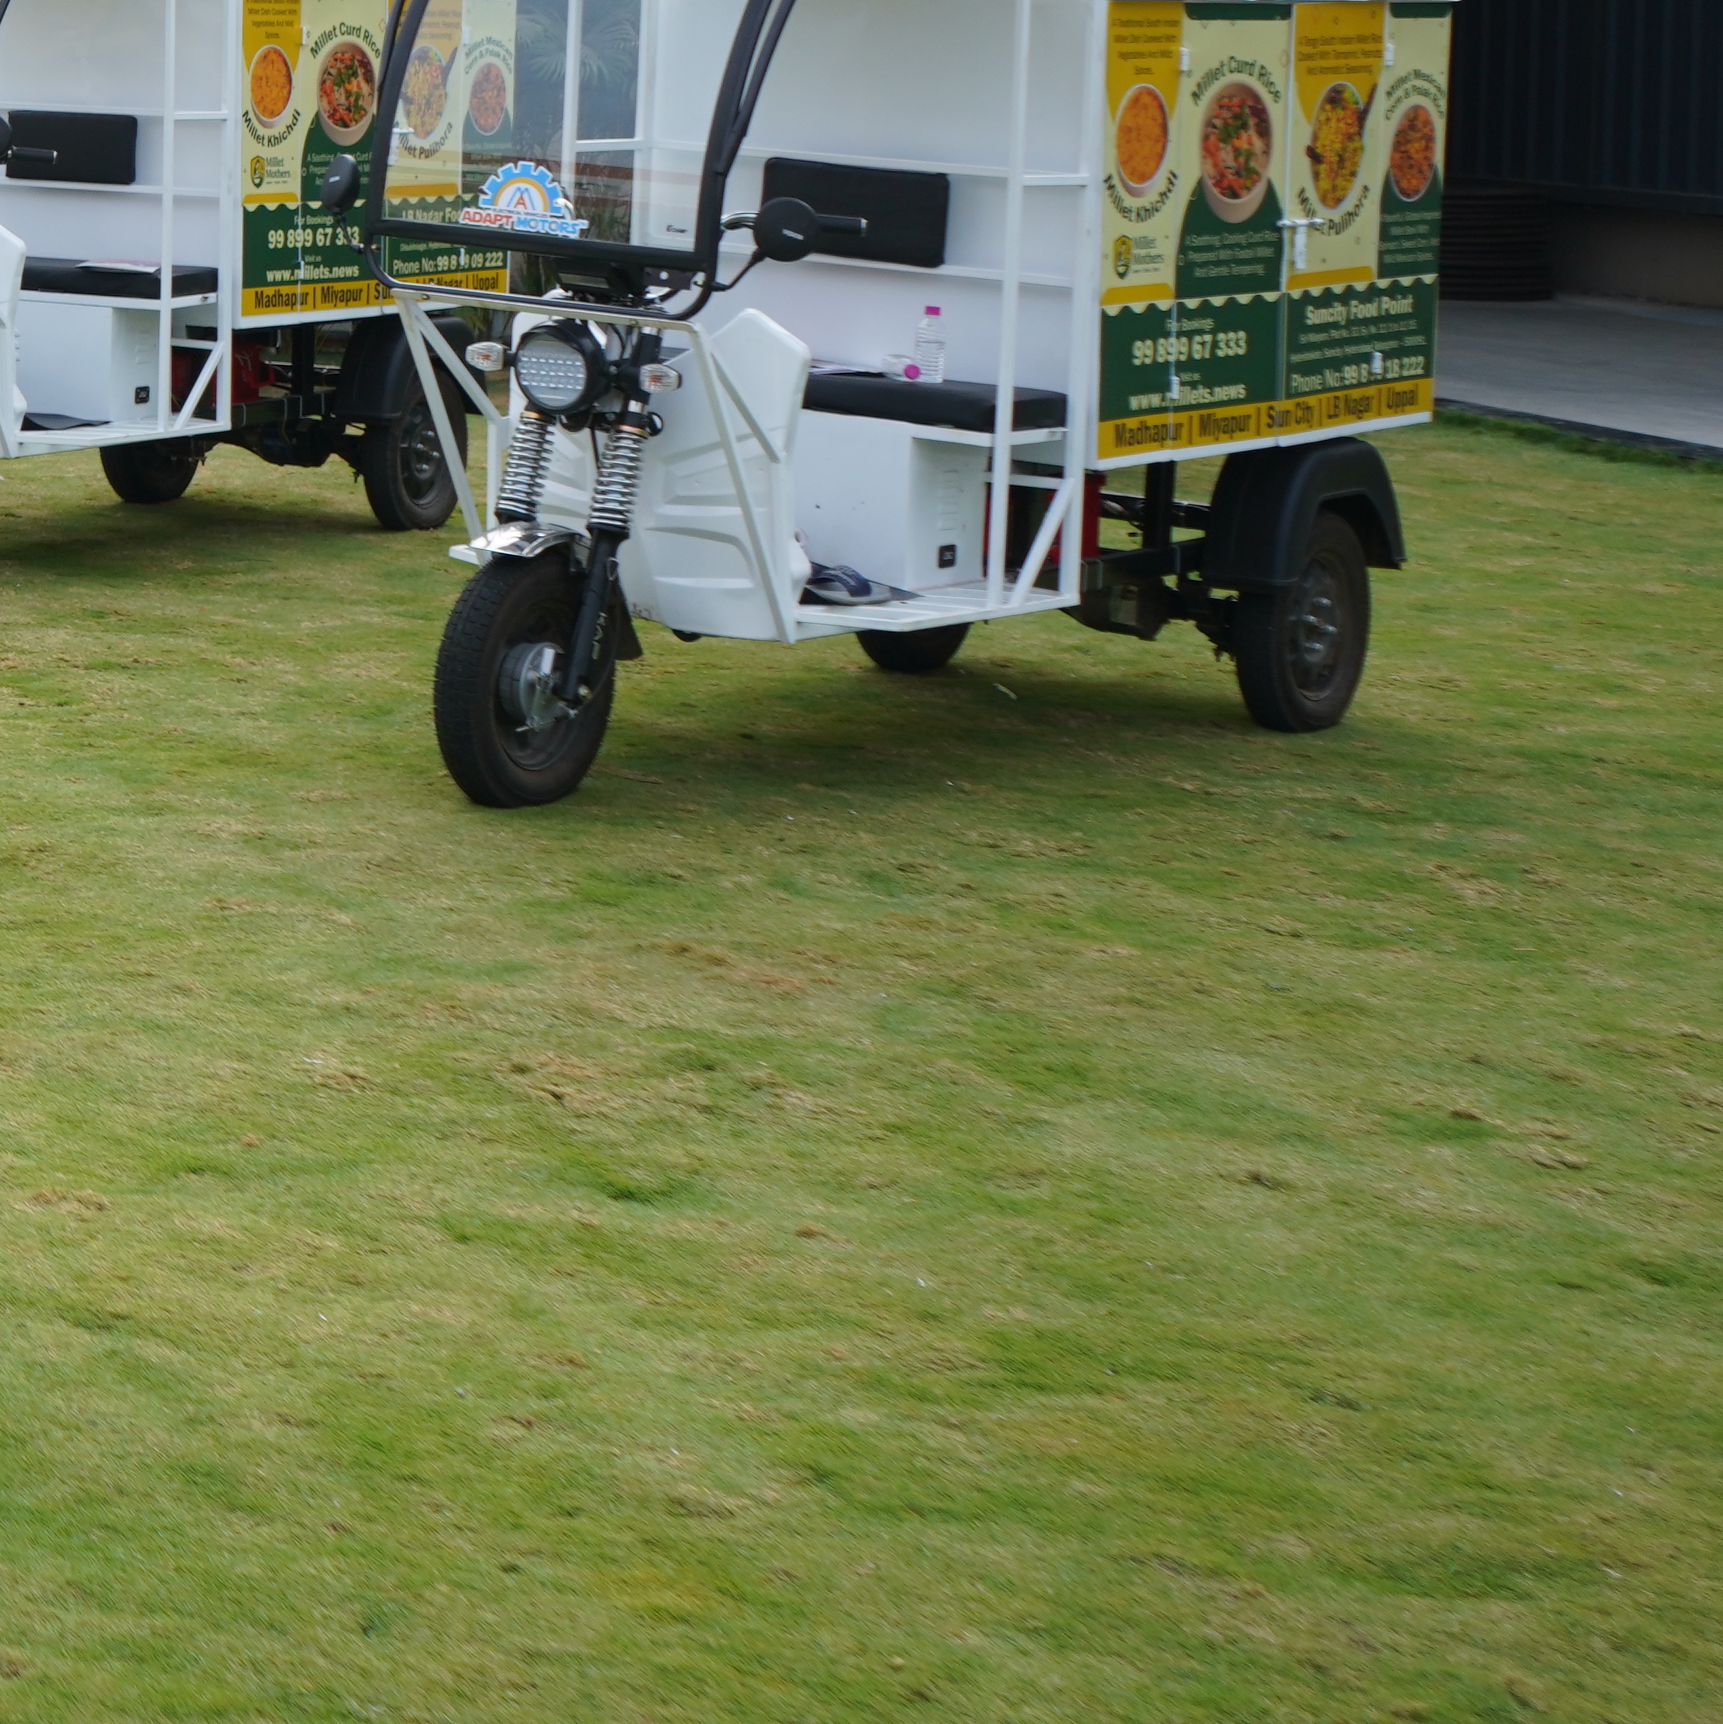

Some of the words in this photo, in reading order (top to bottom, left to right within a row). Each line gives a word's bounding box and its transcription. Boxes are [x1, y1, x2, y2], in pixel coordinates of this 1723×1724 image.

[461, 210, 513, 227] ADAPT
[515, 217, 578, 234] MOTORS
[255, 288, 309, 310] Madhapur
[321, 285, 362, 307] Miyapur
[1305, 302, 1347, 326] Suncity
[1350, 299, 1377, 320] Food
[1379, 295, 1413, 315] Point
[1115, 420, 1184, 448] Madhapur
[1198, 412, 1252, 440] Miyapur
[1387, 385, 1418, 410] Uppal
